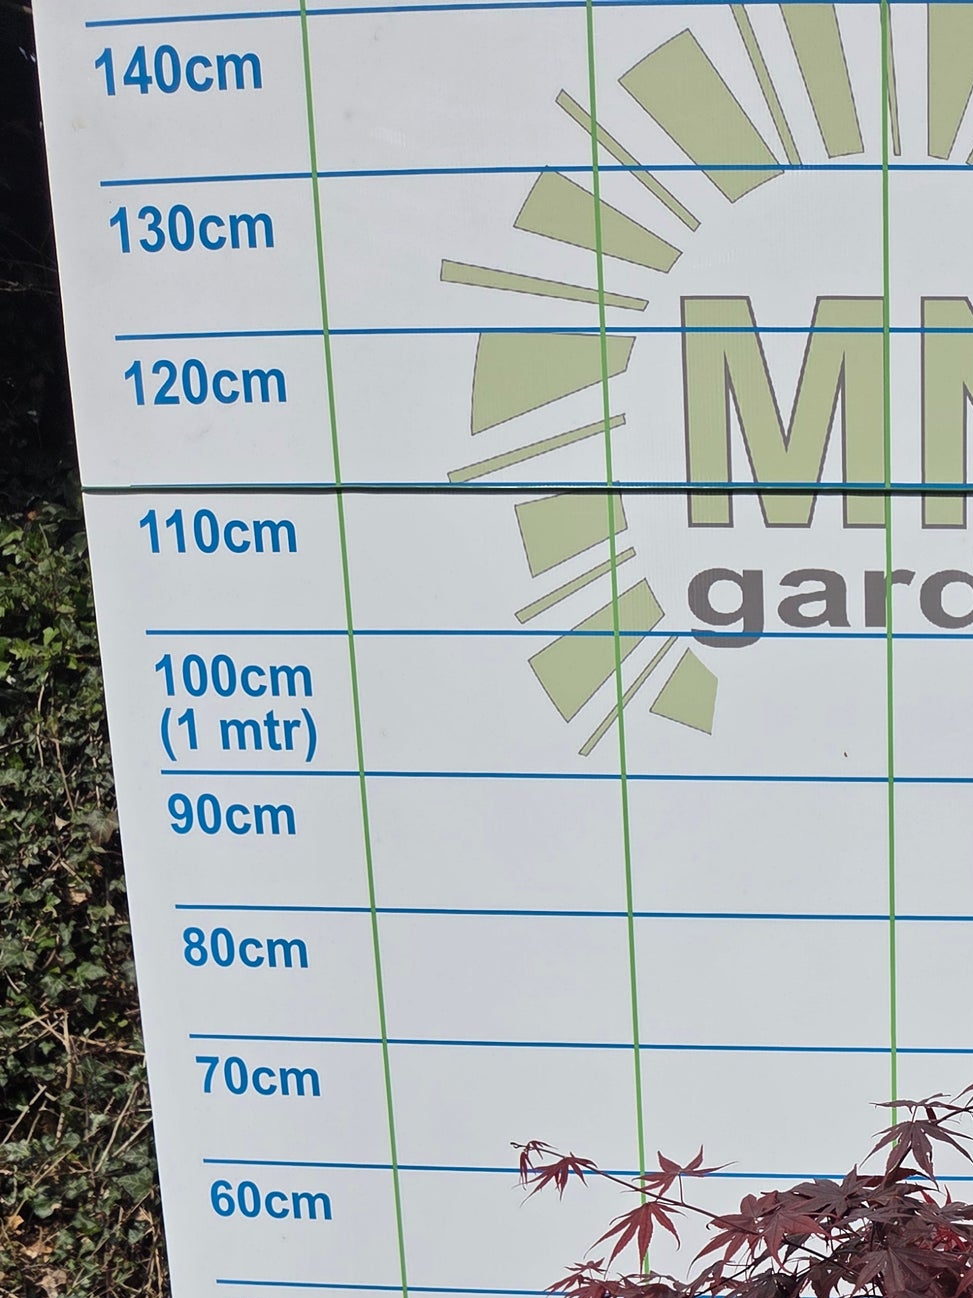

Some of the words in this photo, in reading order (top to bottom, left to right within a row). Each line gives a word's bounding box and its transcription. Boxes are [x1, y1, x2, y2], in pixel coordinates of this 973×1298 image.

[95, 44, 261, 95] 140cm
[110, 204, 273, 252] 130cm
[124, 358, 286, 405] 120cm
[139, 509, 297, 553] 110cm
[155, 654, 312, 697] 100cm
[161, 708, 199, 762] (1
[220, 708, 317, 762] mtr)
[168, 793, 296, 835] 90cm
[183, 927, 308, 968] 80cm
[196, 1056, 320, 1096] 70cm
[210, 1180, 332, 1220] 60cm
